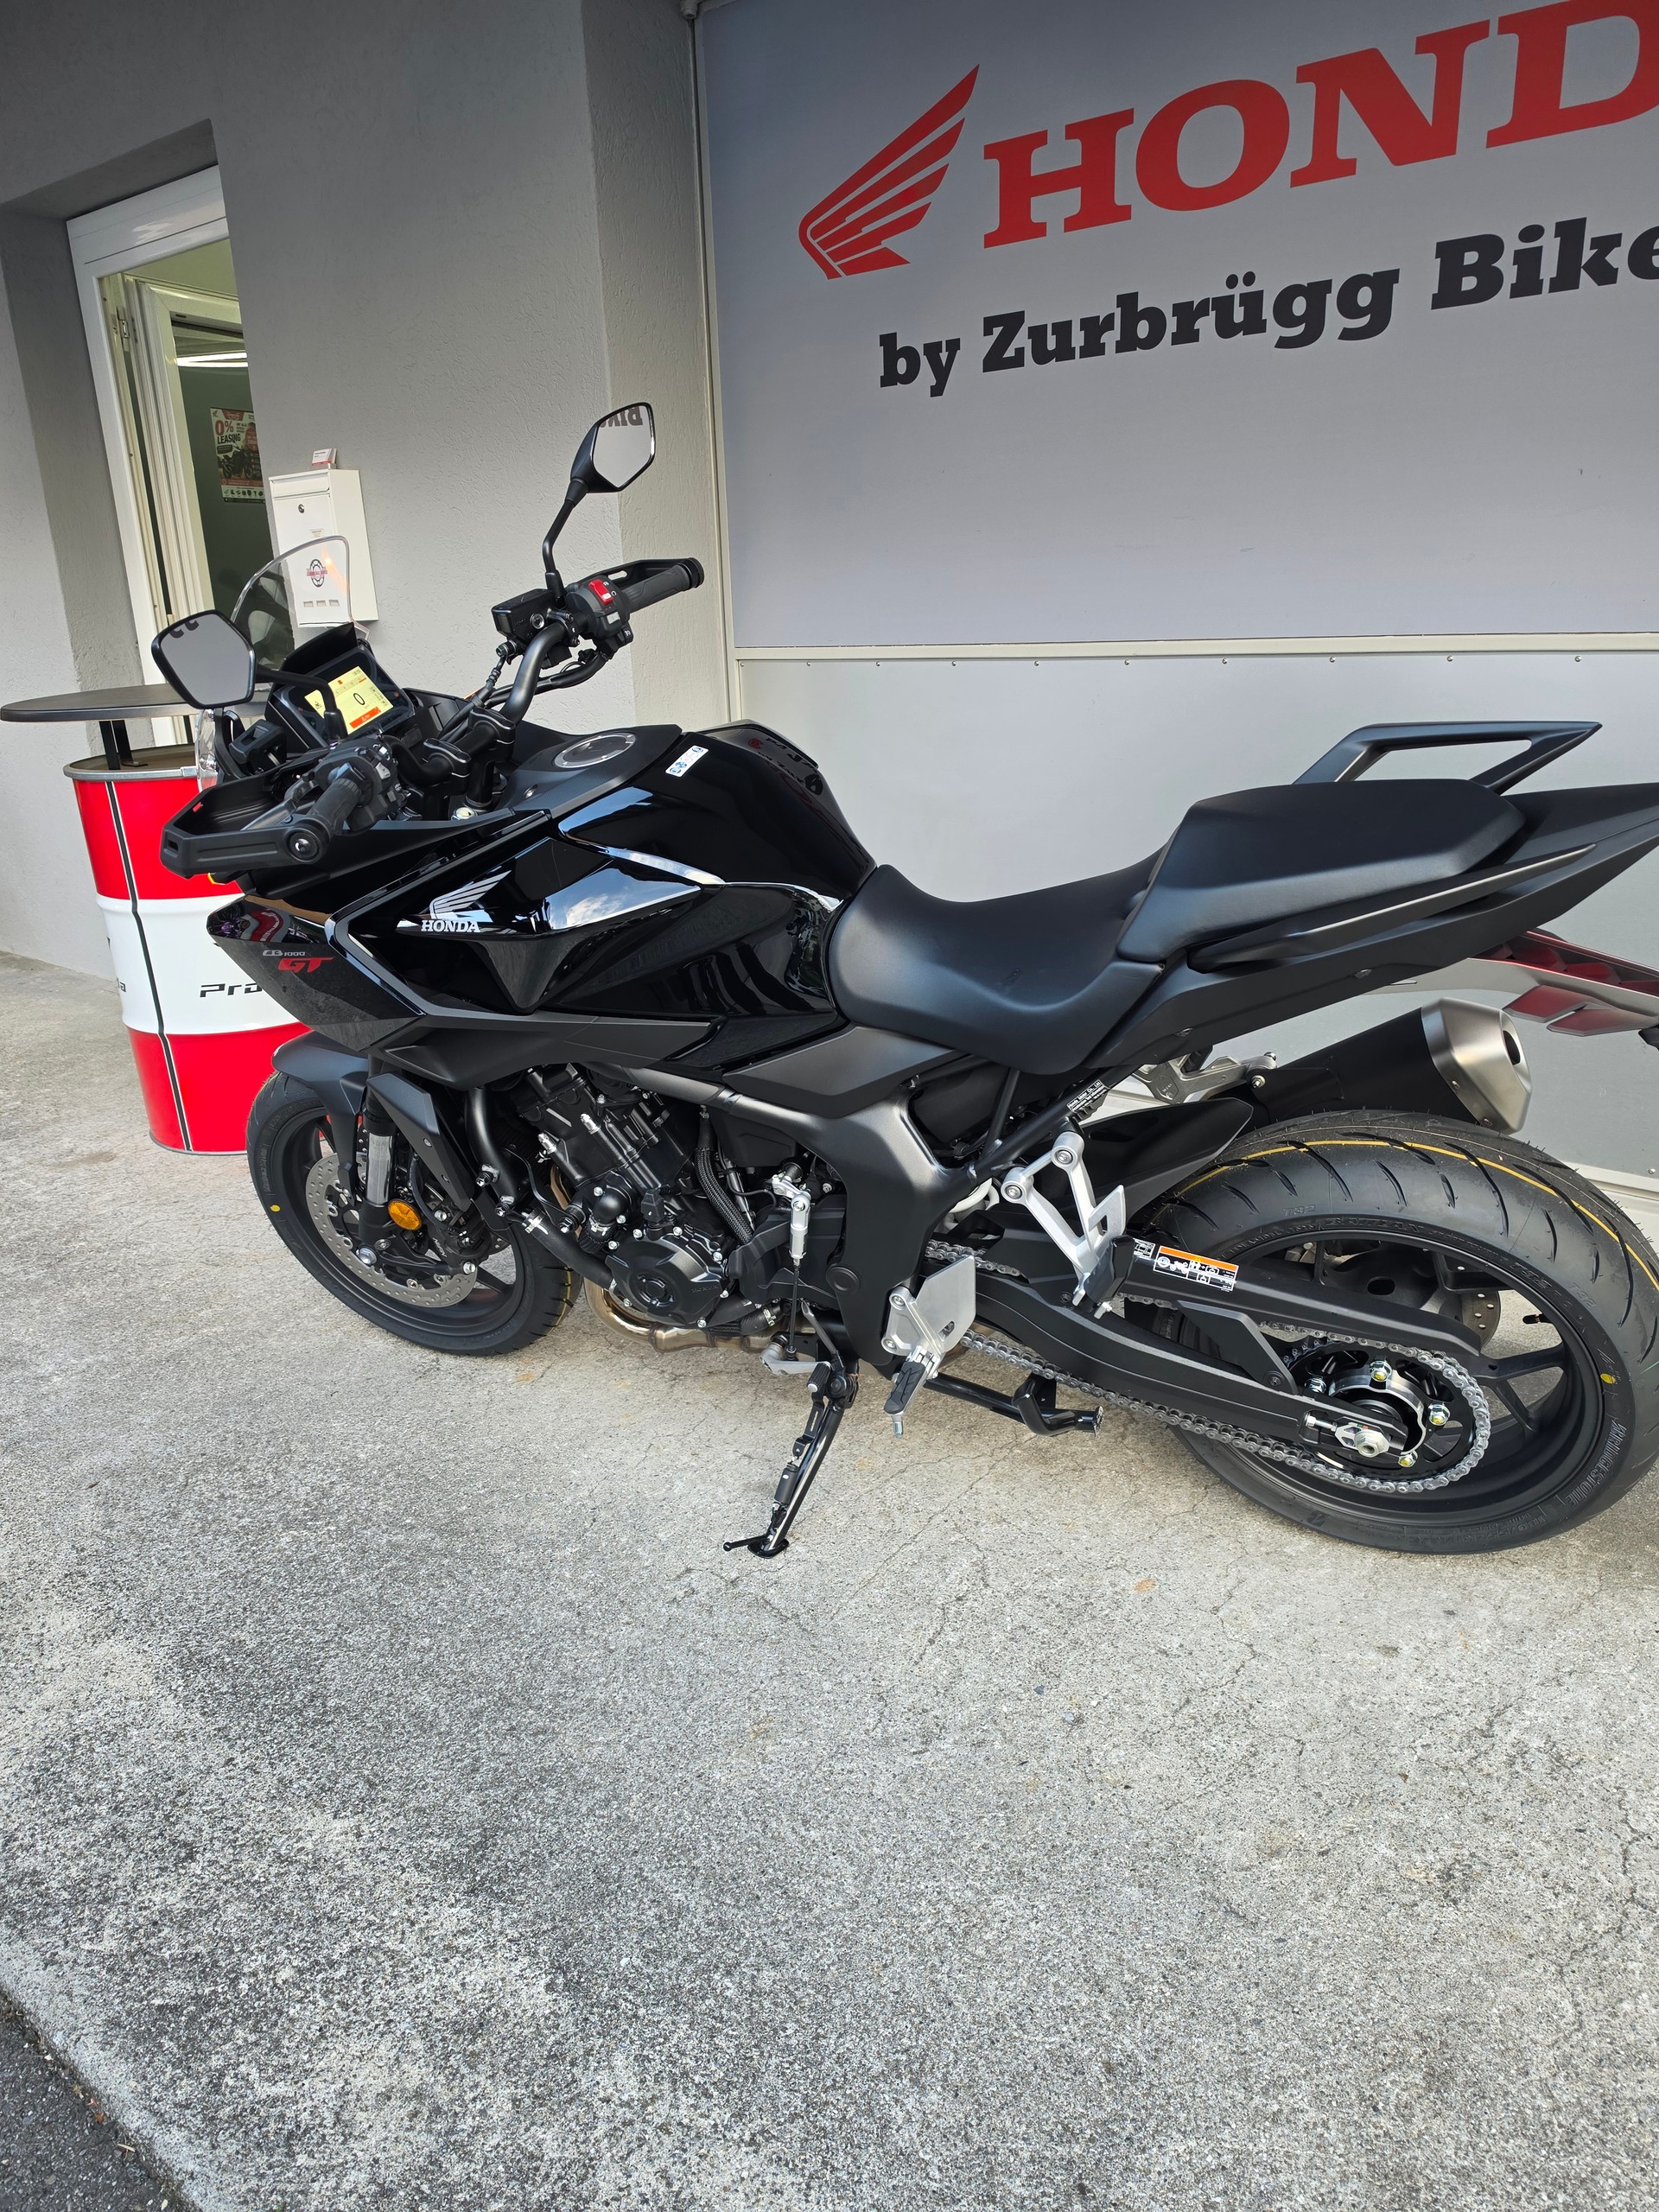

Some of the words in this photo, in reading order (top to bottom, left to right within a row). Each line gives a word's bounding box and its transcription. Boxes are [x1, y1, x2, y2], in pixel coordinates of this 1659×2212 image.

[879, 333, 961, 397] by
[983, 269, 1400, 373] Zurbrügg
[215, 420, 234, 436] 0%
[217, 433, 241, 445] LEASING
[353, 692, 365, 706] 0
[421, 919, 481, 933] HONDA
[278, 957, 334, 973] GT
[1565, 1420, 1627, 1507] BRIDGESTONE
